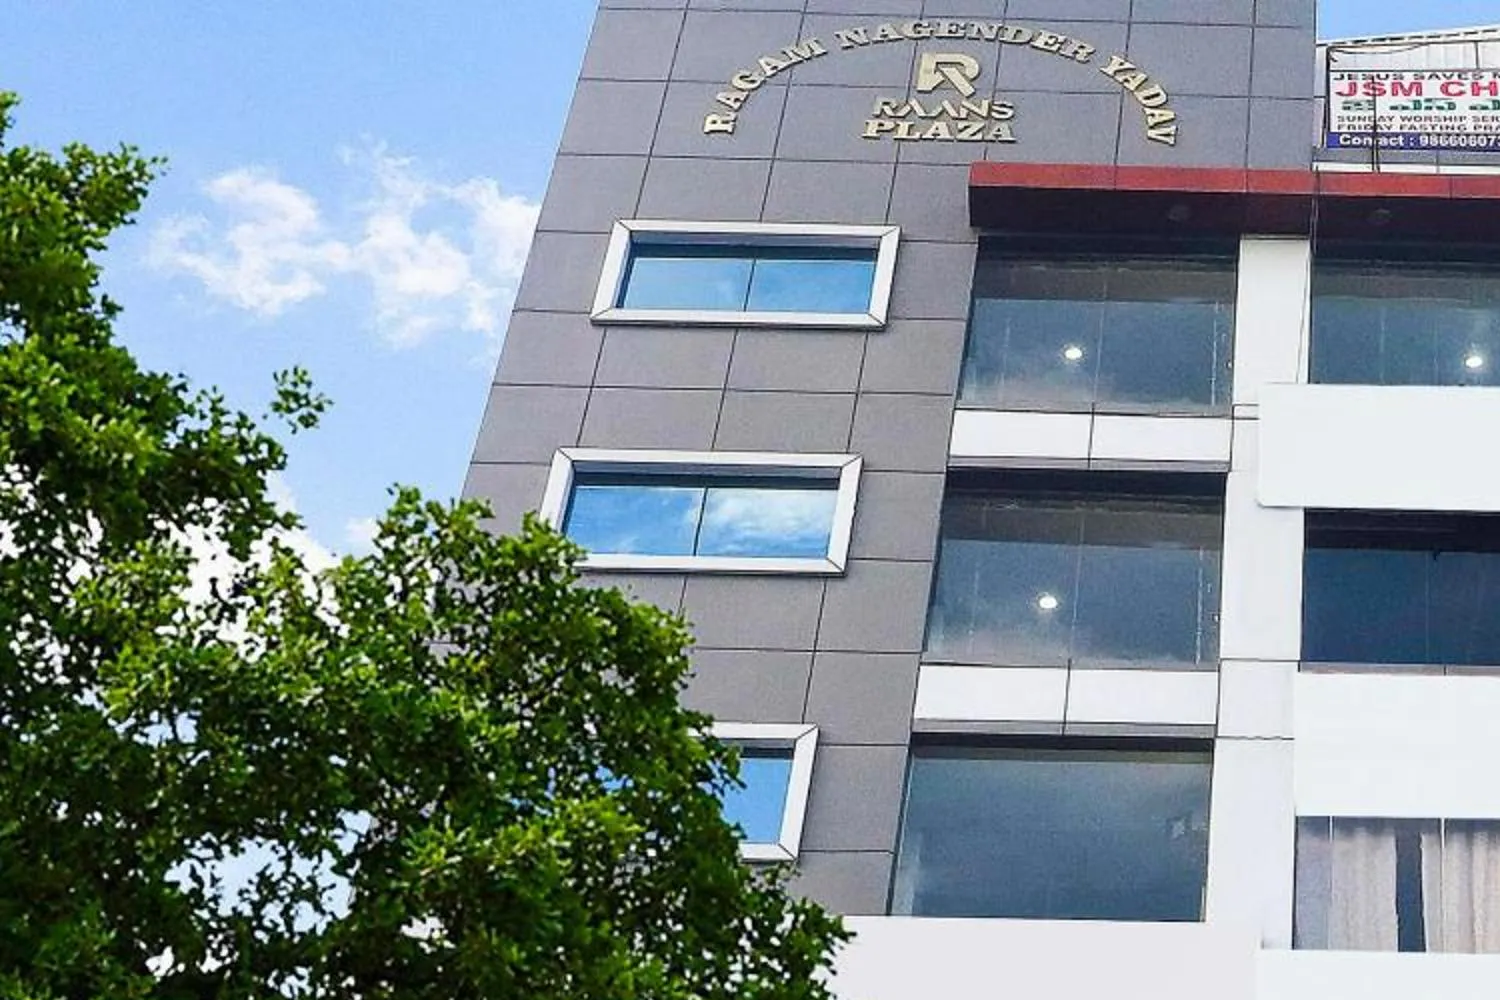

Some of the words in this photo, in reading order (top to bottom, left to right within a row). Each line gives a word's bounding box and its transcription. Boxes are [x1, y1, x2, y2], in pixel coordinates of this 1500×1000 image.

[704, 37, 828, 137] RAGAM
[834, 19, 1096, 64] NAGENDER
[1100, 54, 1179, 146] YADAV
[1333, 72, 1404, 81] JESUS
[1412, 72, 1484, 81] SAVES
[1334, 80, 1424, 97] JSM
[1336, 114, 1395, 124] SUNDAY
[1399, 114, 1467, 124] WORSHIP
[861, 118, 1018, 143] PLAZA
[1336, 122, 1394, 132] FRIDAY
[1399, 123, 1467, 132] FASTING
[1339, 133, 1404, 147] Conact
